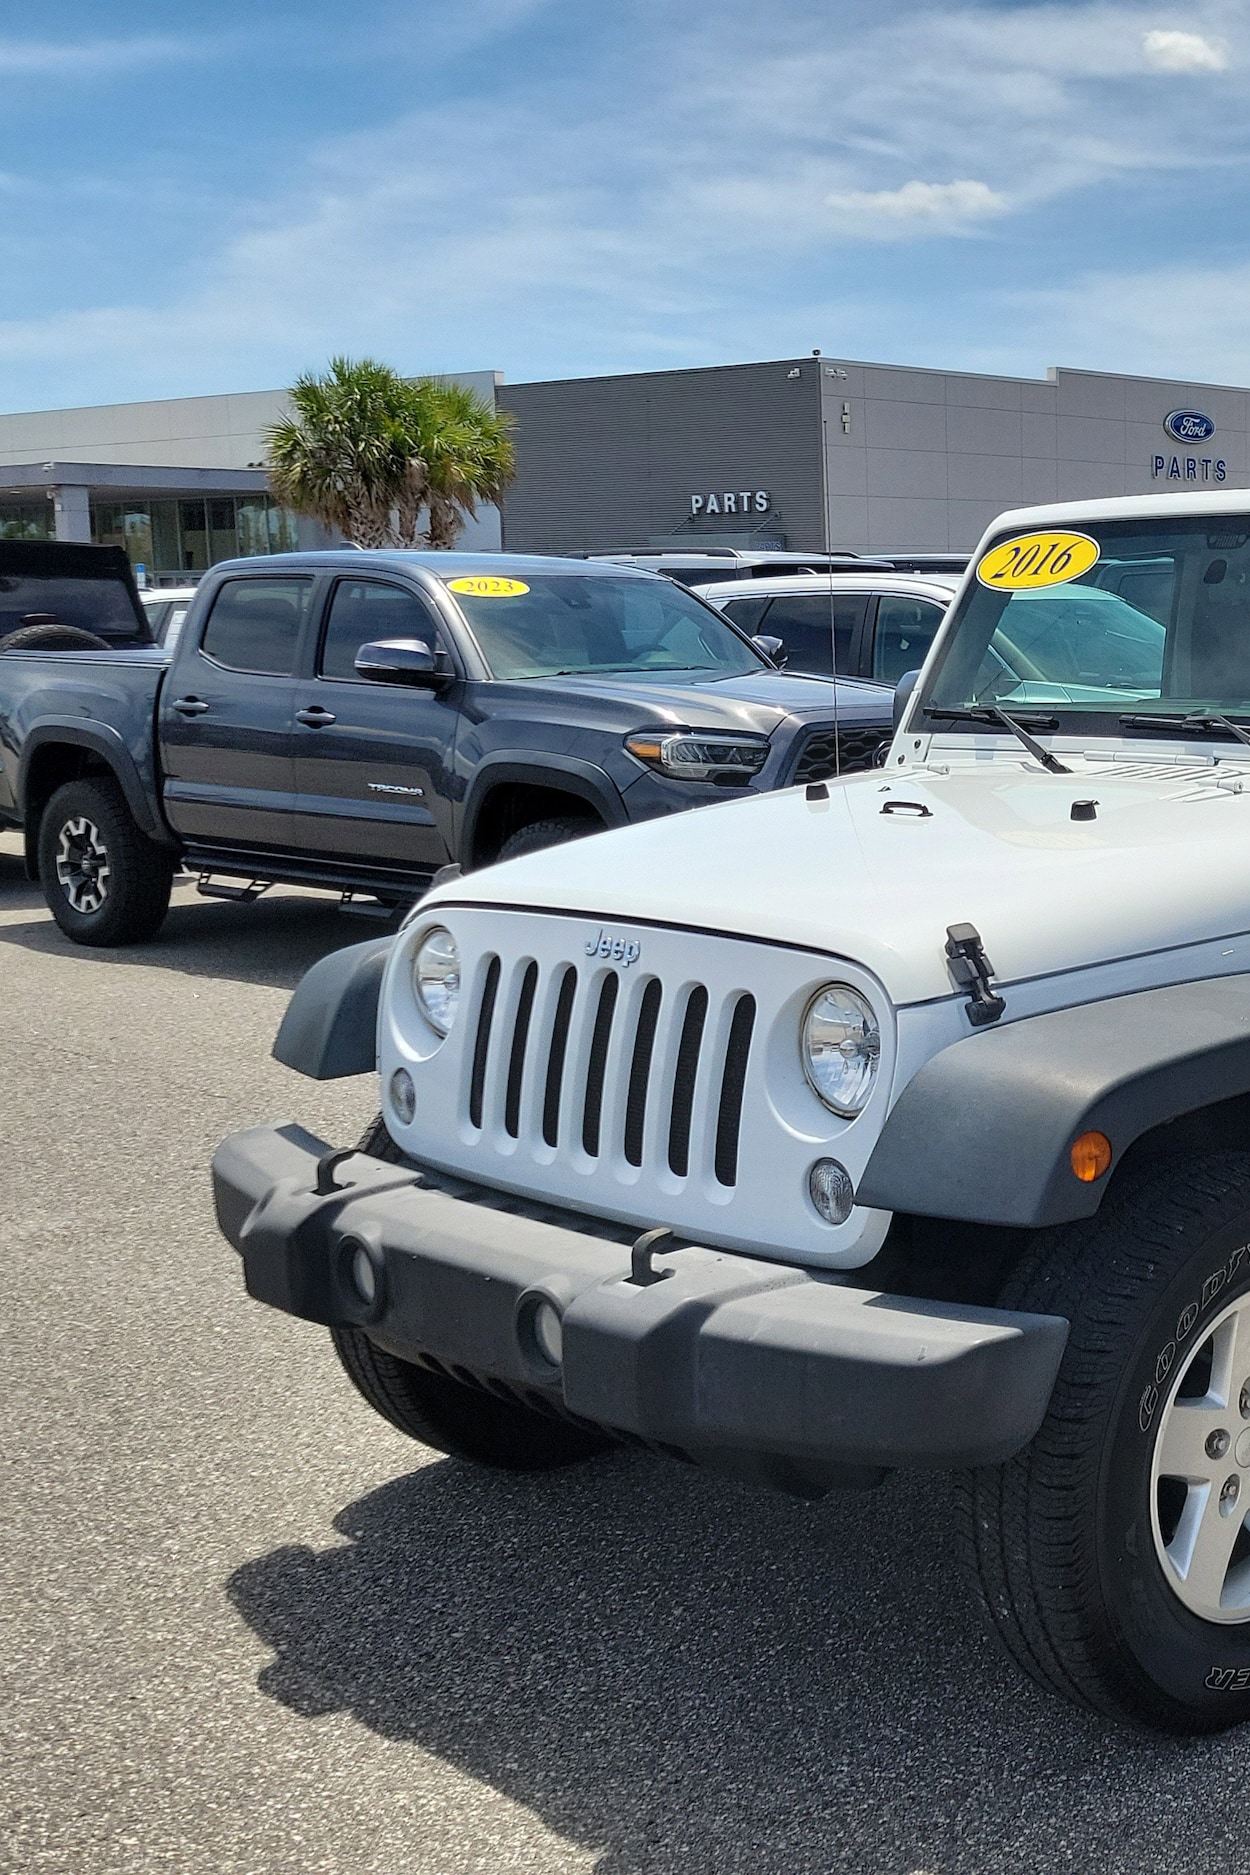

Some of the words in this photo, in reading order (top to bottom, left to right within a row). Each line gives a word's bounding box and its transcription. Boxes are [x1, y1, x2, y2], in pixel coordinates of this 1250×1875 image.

[1180, 416, 1207, 437] Ford
[1153, 454, 1227, 482] PARTS
[691, 490, 769, 515] PARTS
[989, 540, 1084, 579] 2016
[465, 580, 514, 593] 2023
[584, 929, 641, 968] Jeep
